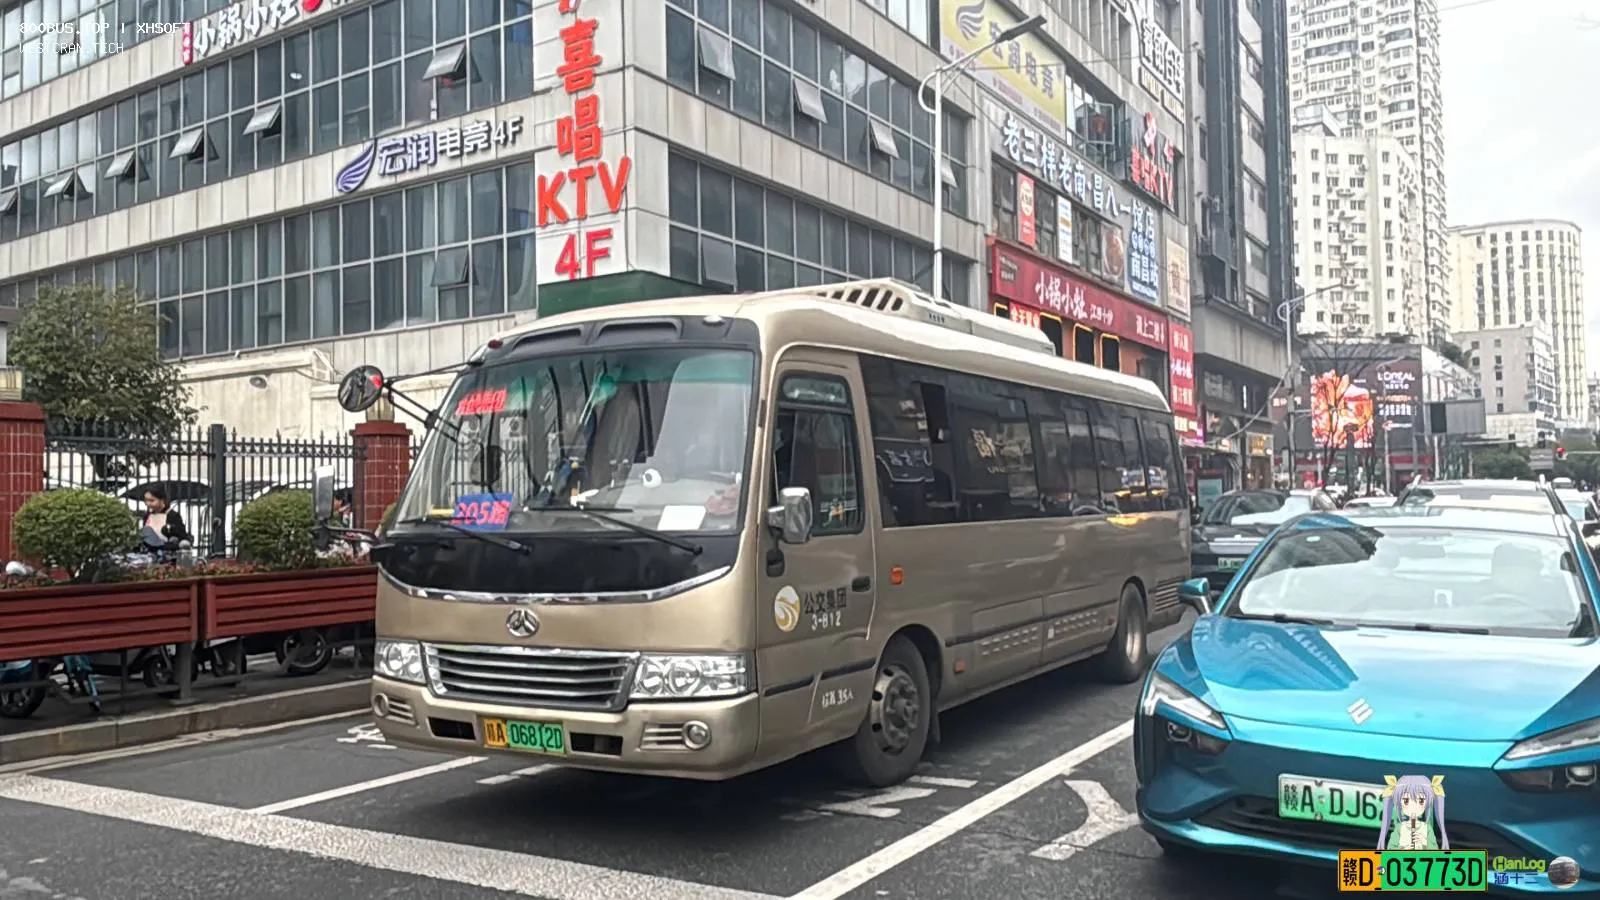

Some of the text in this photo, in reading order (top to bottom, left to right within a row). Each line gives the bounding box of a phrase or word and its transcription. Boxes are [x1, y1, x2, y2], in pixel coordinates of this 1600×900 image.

[557, 0, 602, 163] 喜唱
[537, 156, 631, 228] KTV
[555, 227, 613, 281] 4F
[1035, 271, 1089, 320] 小锅小灶
[804, 587, 847, 614] 公交集团
[811, 610, 841, 631] 3-812
[510, 723, 563, 749] 06812D
[1283, 783, 1315, 814] 赣A
